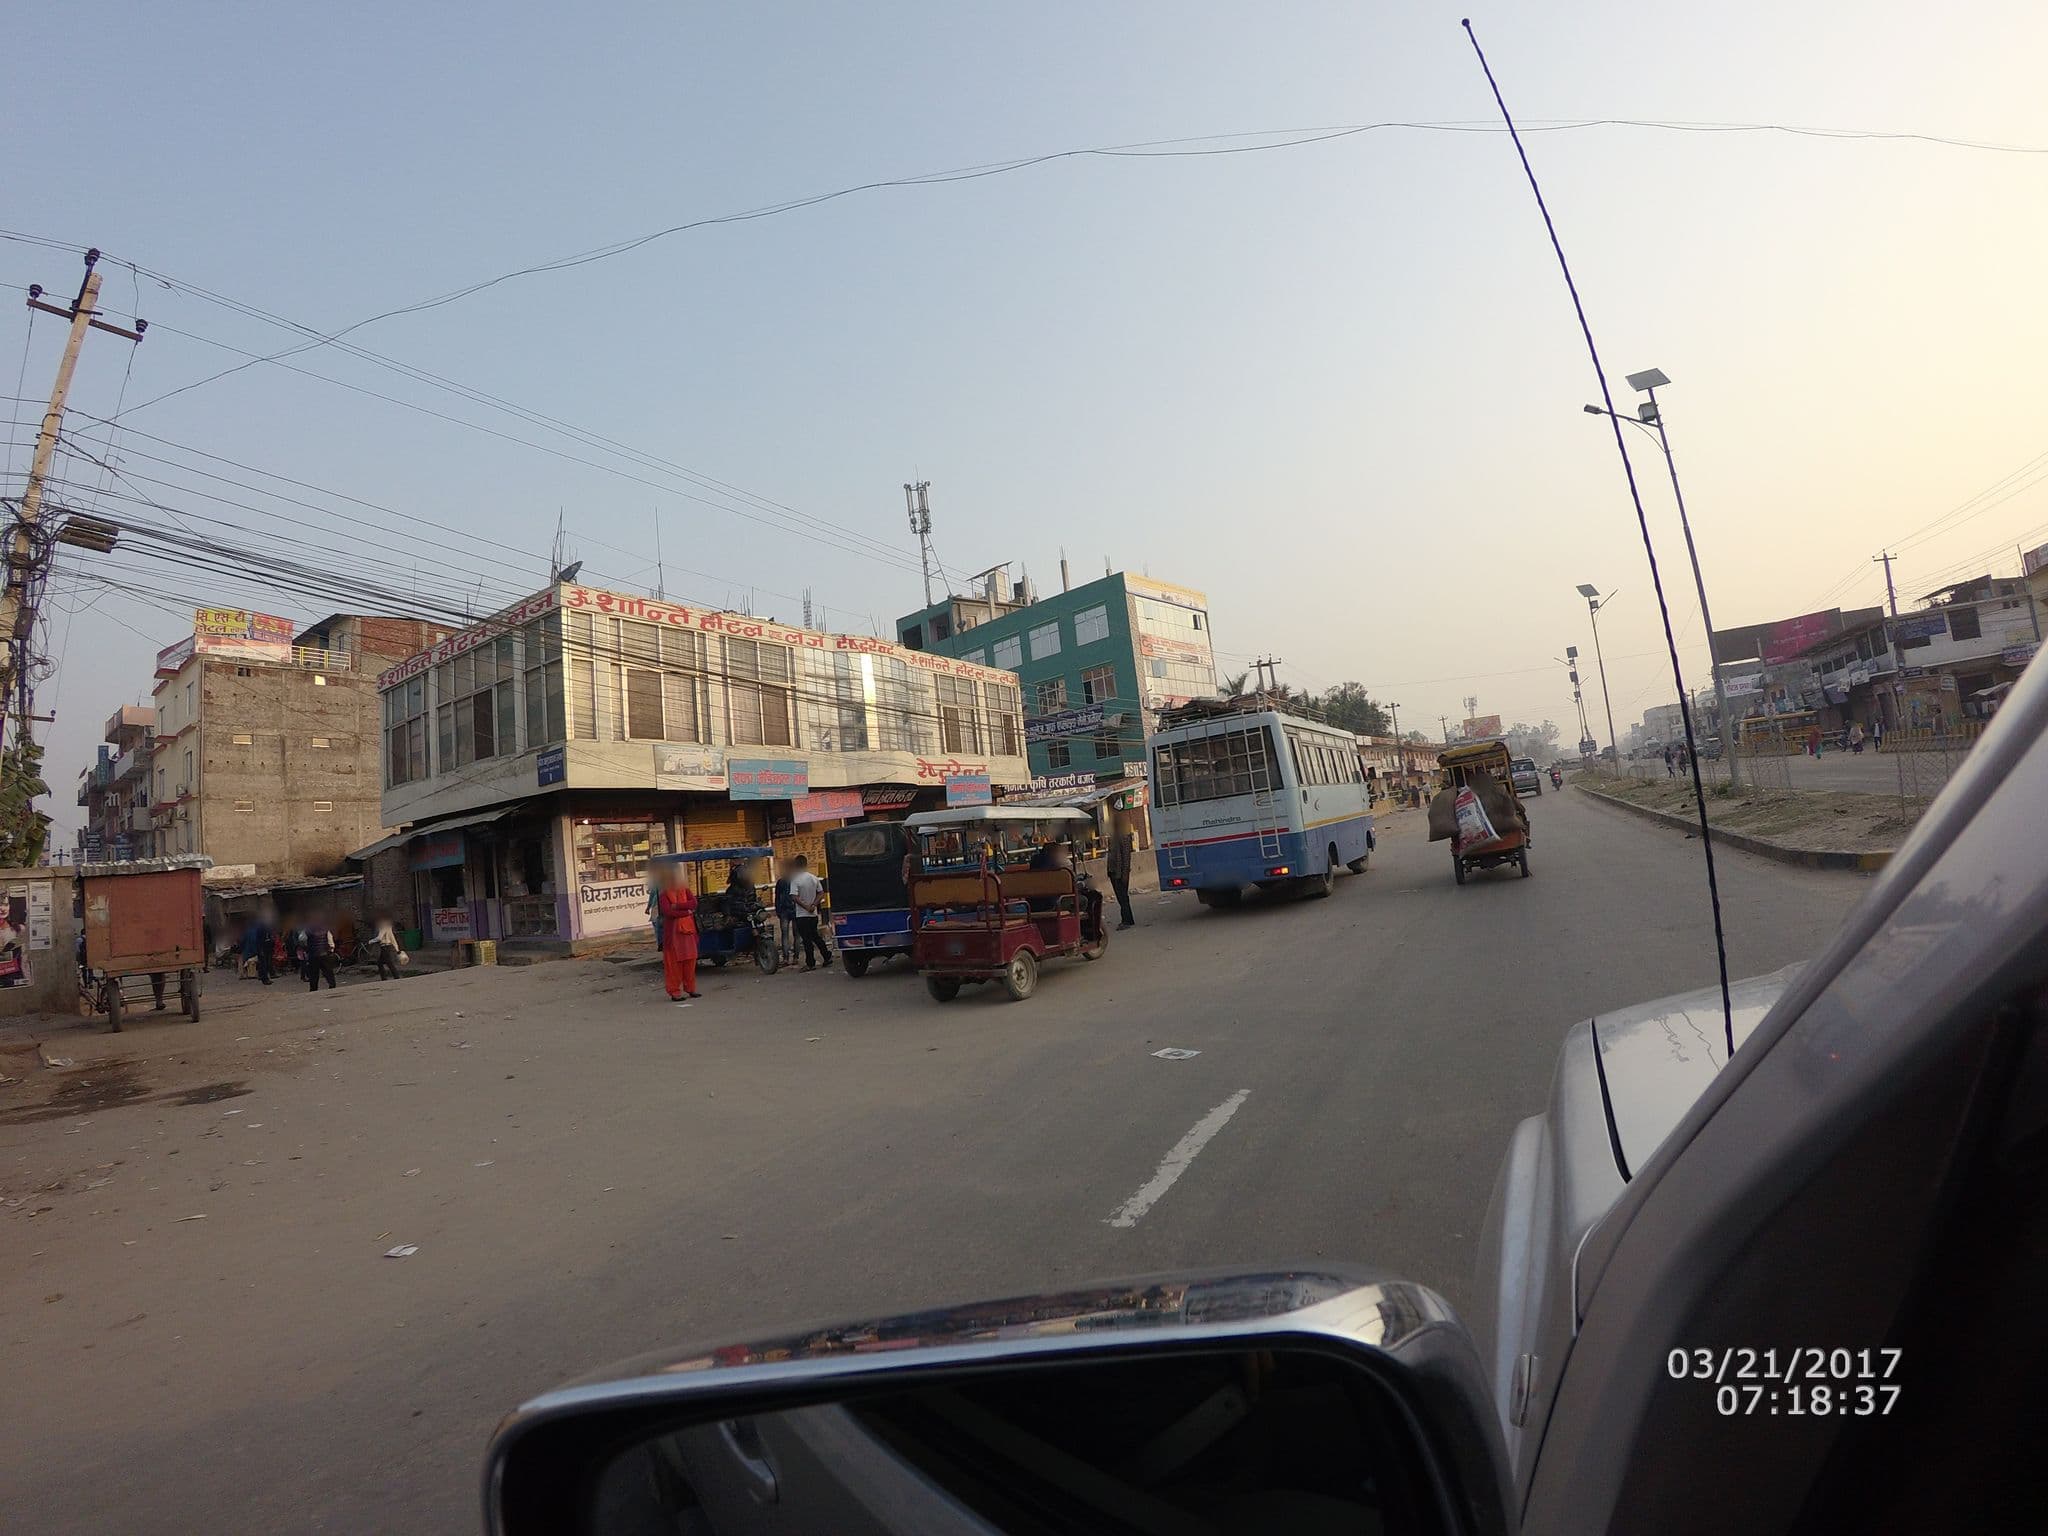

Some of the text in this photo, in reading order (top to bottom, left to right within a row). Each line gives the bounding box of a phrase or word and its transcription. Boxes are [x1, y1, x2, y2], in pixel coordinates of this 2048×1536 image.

[700, 614, 764, 637] होटल
[581, 885, 611, 903] धिरज
[612, 883, 645, 899] जनरल
